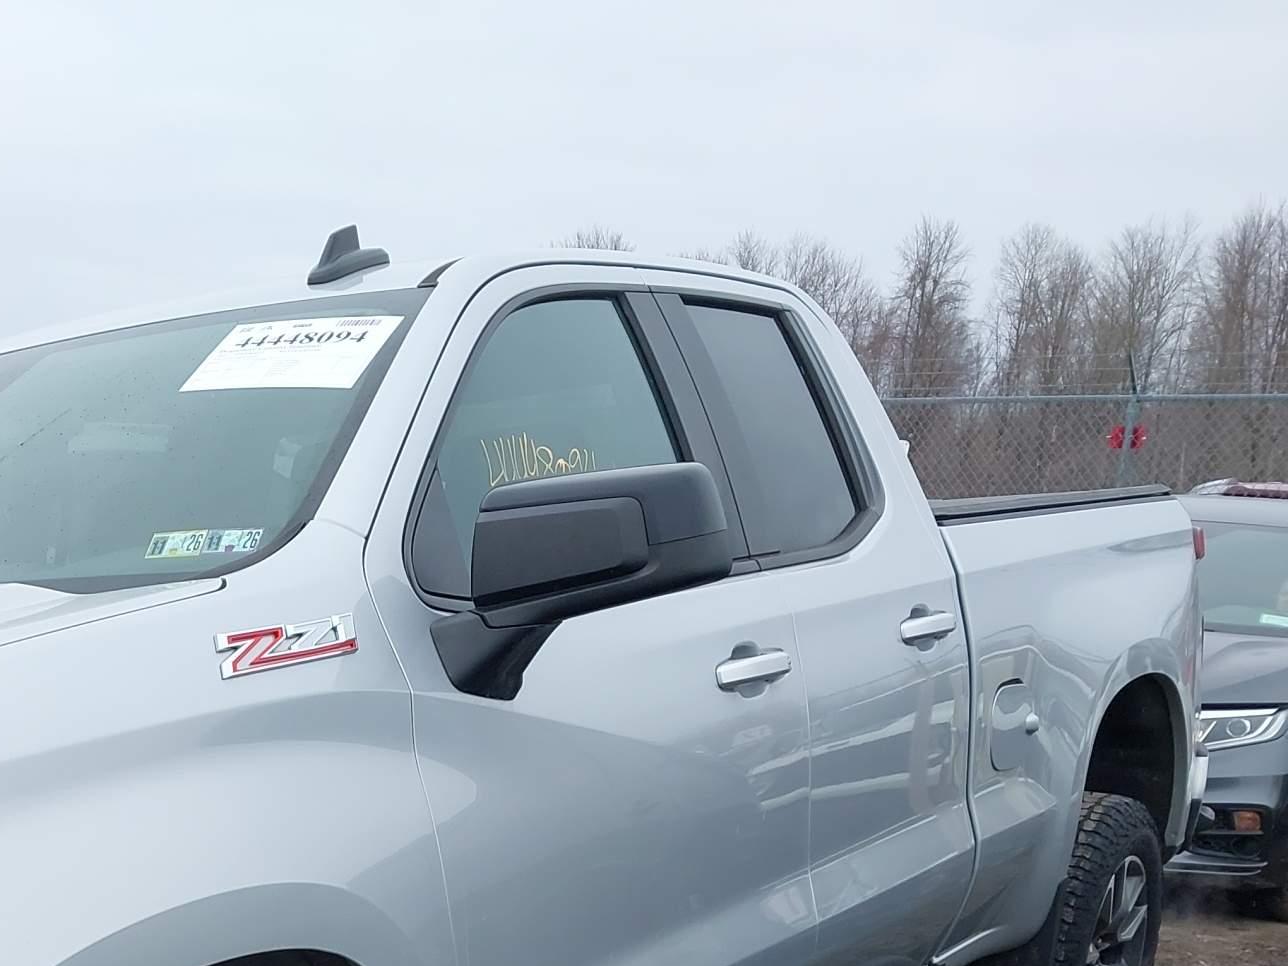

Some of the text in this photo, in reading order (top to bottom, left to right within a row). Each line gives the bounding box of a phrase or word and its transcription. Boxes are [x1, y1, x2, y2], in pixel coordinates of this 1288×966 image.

[235, 330, 369, 348] 44448094
[186, 533, 204, 552] 26
[243, 530, 261, 549] 26
[213, 612, 359, 680] Z71
